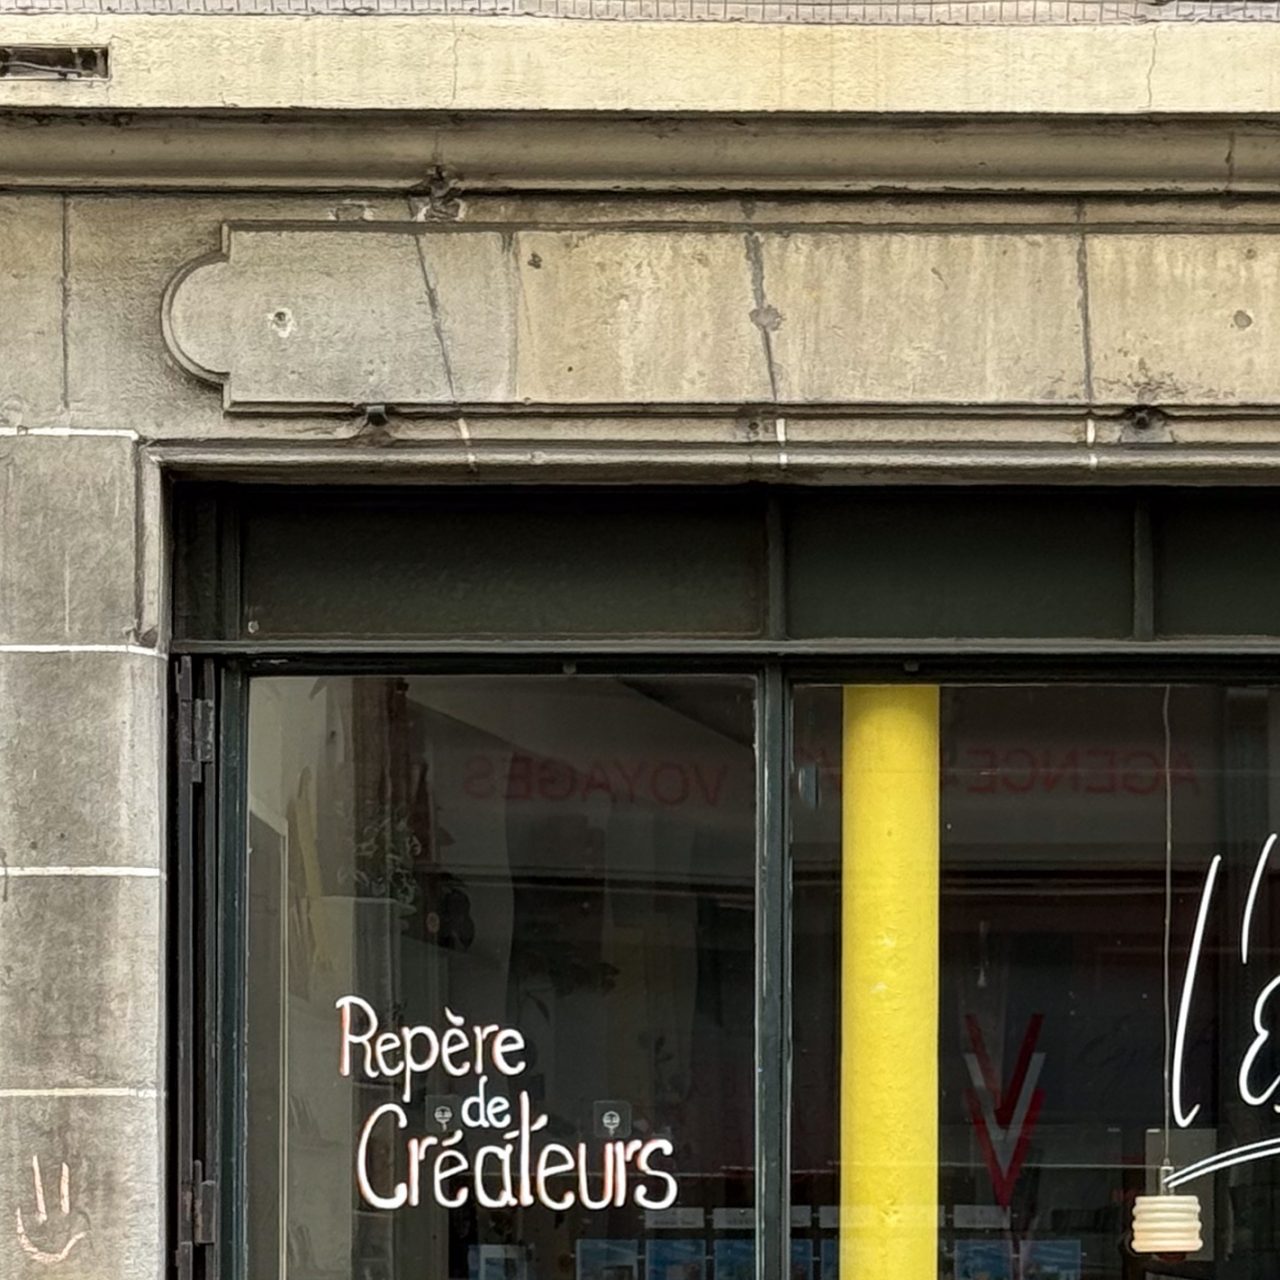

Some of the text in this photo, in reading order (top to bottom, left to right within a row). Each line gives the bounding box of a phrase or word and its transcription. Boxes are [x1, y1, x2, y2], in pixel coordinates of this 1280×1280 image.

[336, 995, 526, 1103] Repère
[461, 1077, 511, 1128] de
[358, 1091, 678, 1210] Créateurs
